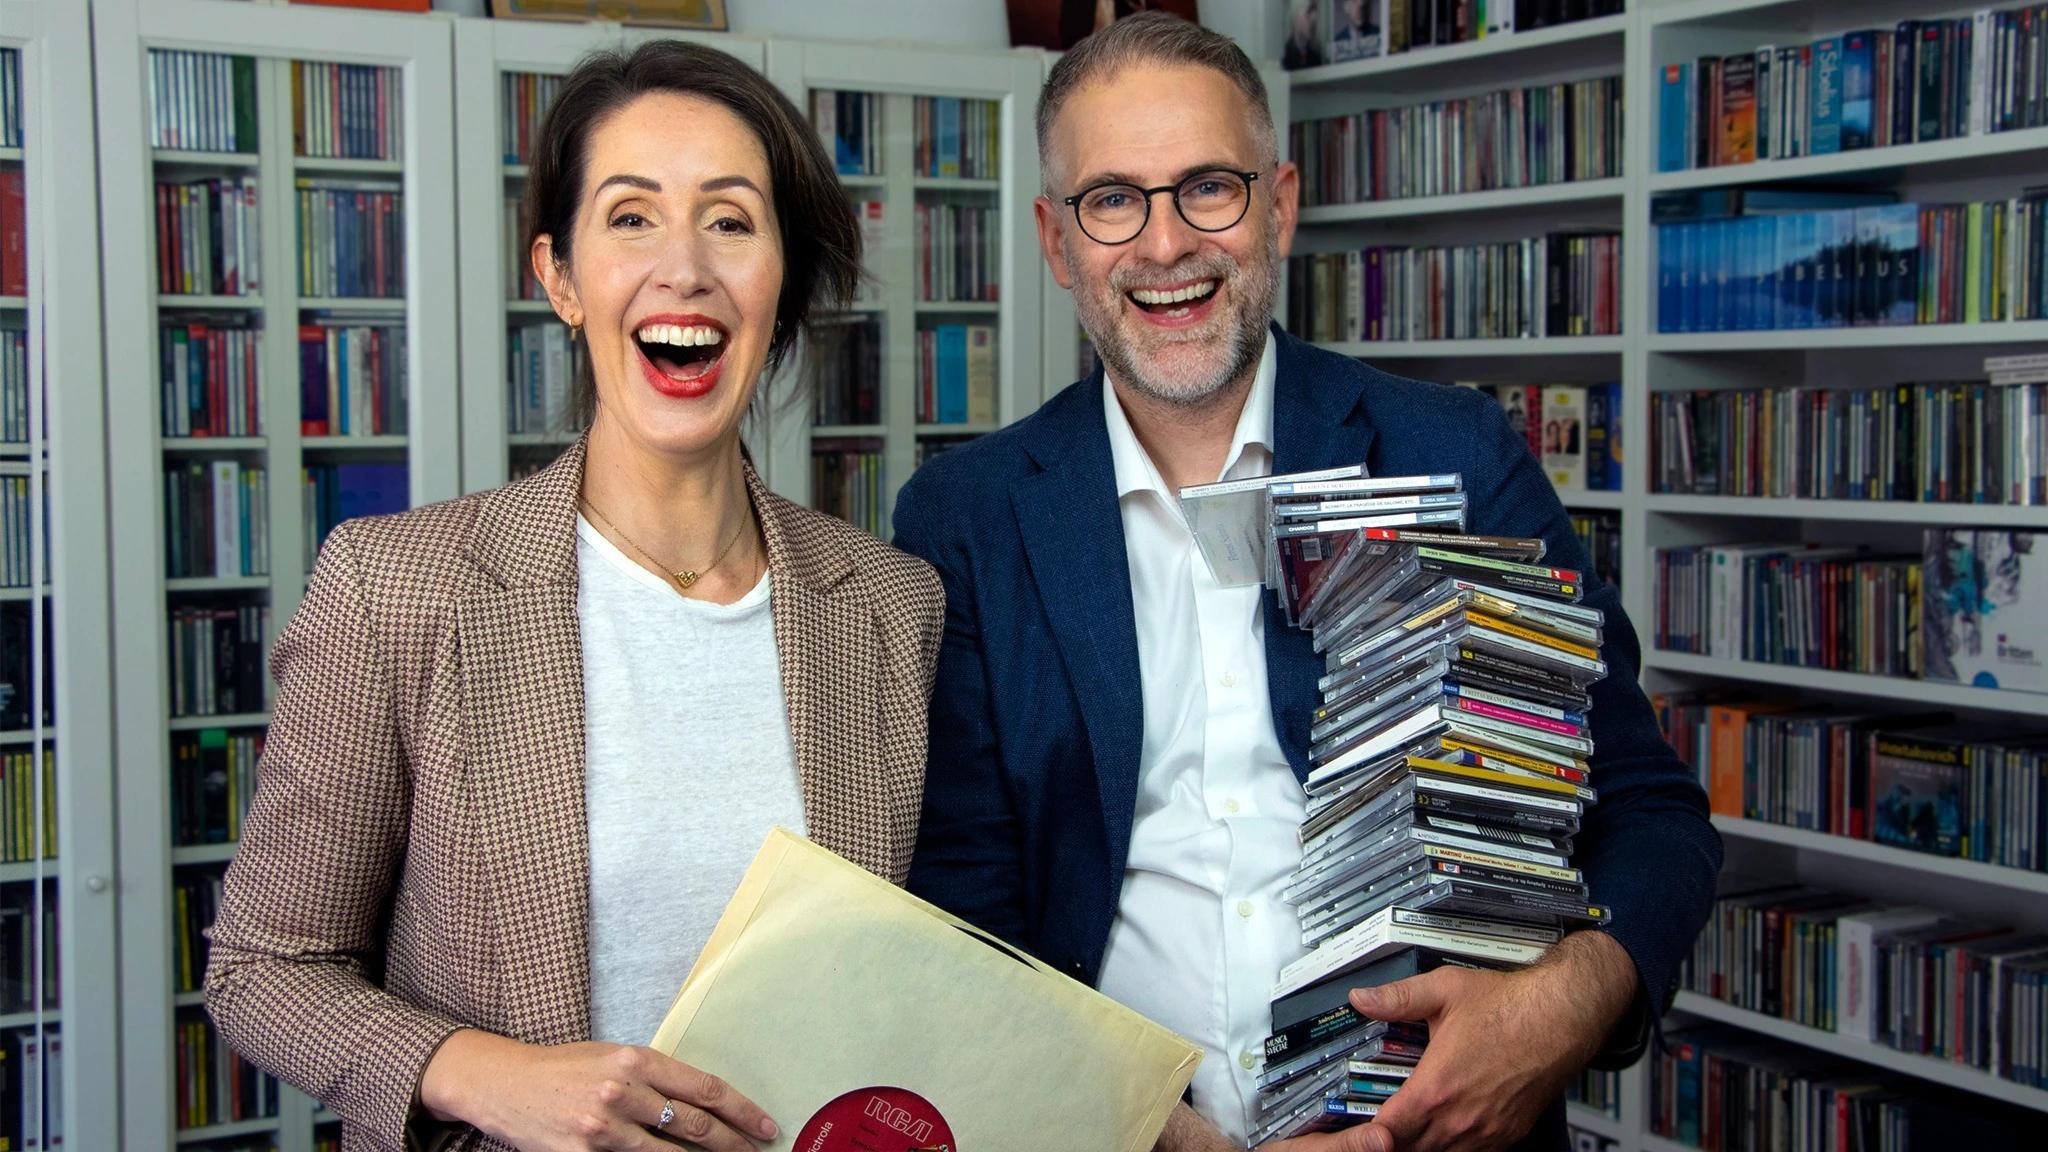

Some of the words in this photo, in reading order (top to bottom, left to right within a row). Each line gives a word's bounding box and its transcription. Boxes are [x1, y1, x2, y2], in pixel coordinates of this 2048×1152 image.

[1817, 51, 1838, 119] Sibelius
[1998, 644, 2034, 659] Britten
[1443, 684, 1458, 692] NAXOS
[1266, 1034, 1288, 1049] MUSICA
[864, 1096, 934, 1144] RCA
[806, 1121, 834, 1152] ictrola
